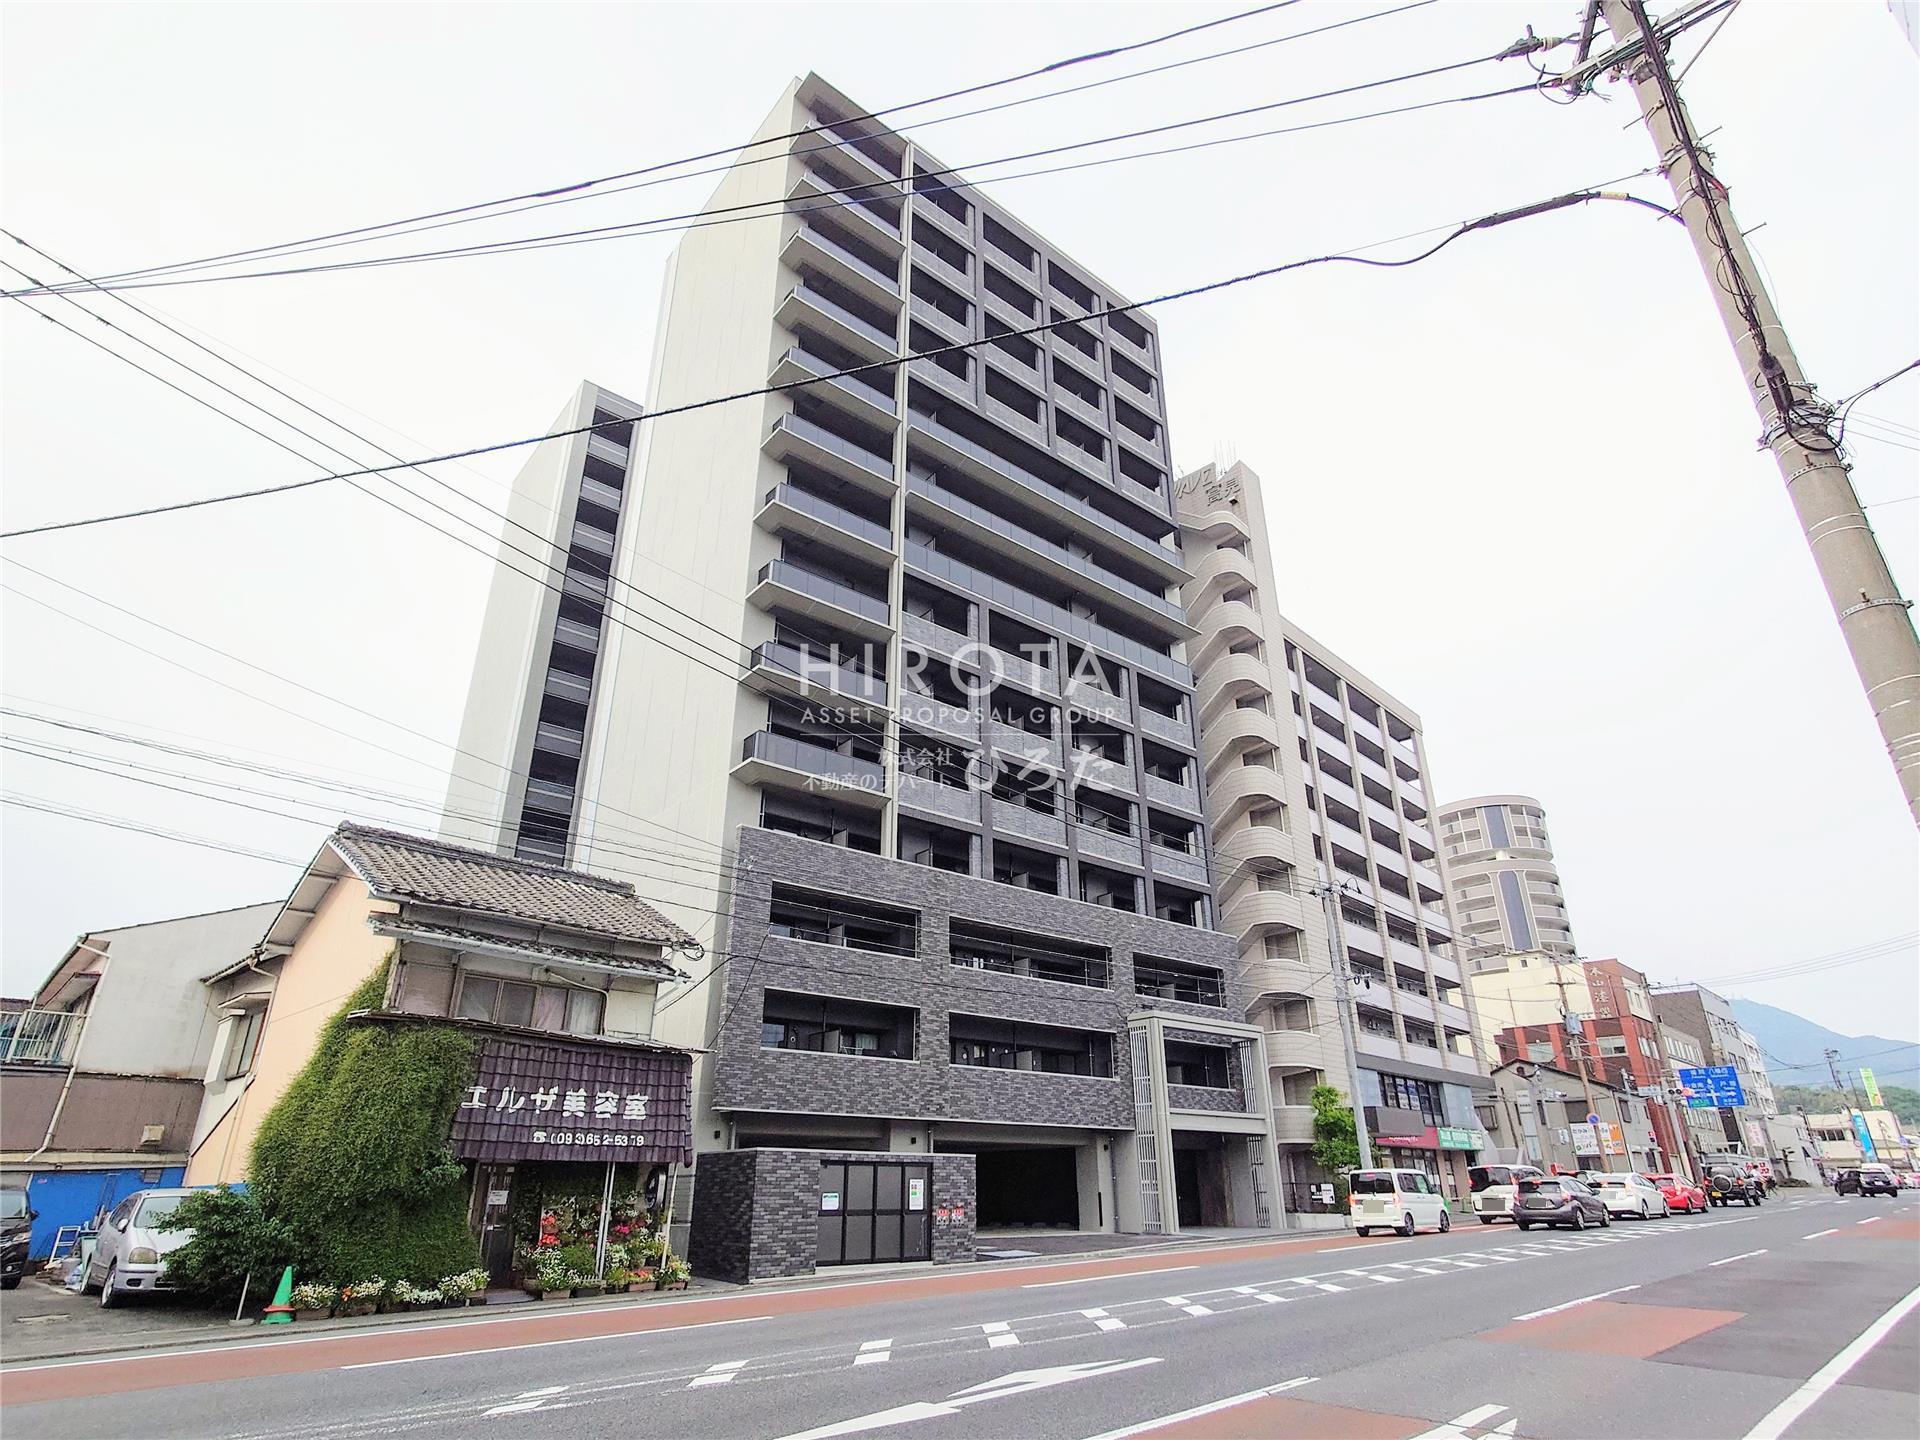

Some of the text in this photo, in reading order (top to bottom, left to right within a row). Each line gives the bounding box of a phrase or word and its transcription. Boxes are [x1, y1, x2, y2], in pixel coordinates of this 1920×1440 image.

[461, 1086, 649, 1120] エルザ美容室
